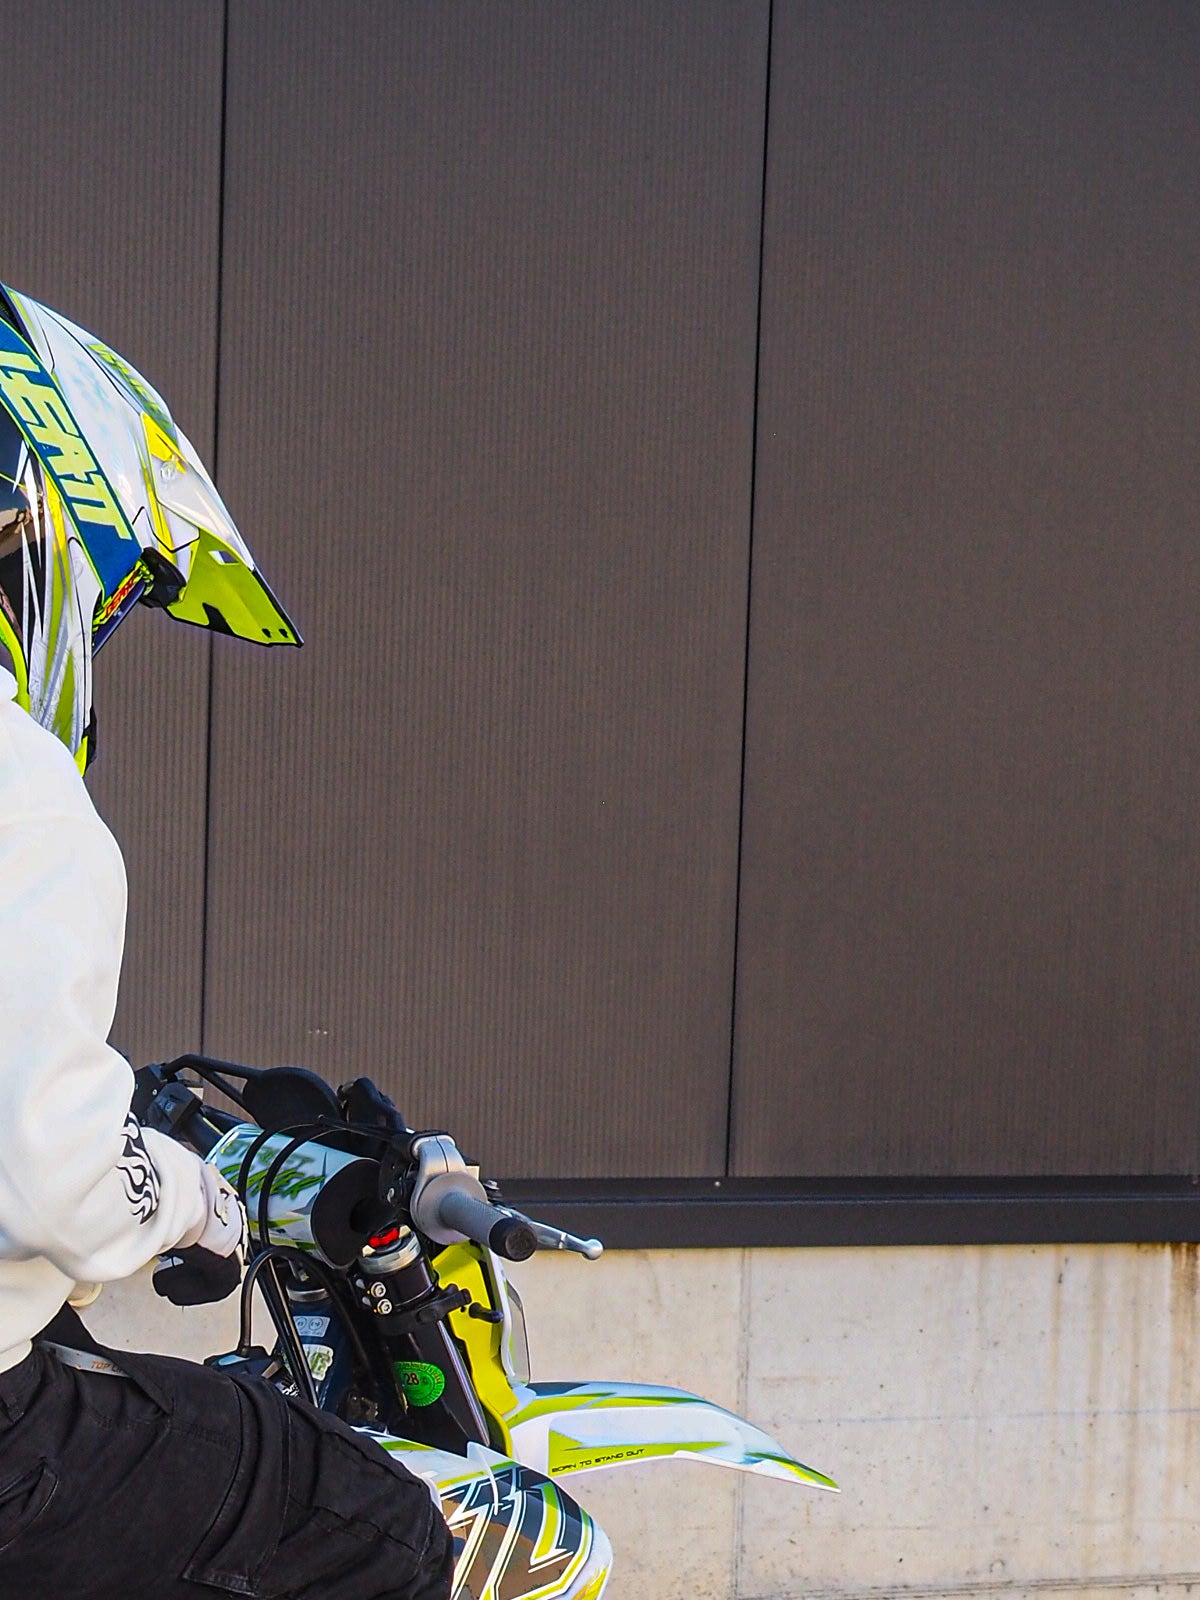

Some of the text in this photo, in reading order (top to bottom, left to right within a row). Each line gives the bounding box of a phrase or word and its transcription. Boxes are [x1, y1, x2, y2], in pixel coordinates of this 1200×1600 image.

[552, 1463, 577, 1473] BORN
[595, 1452, 624, 1463] STAND
[626, 1449, 645, 1457] OUT
